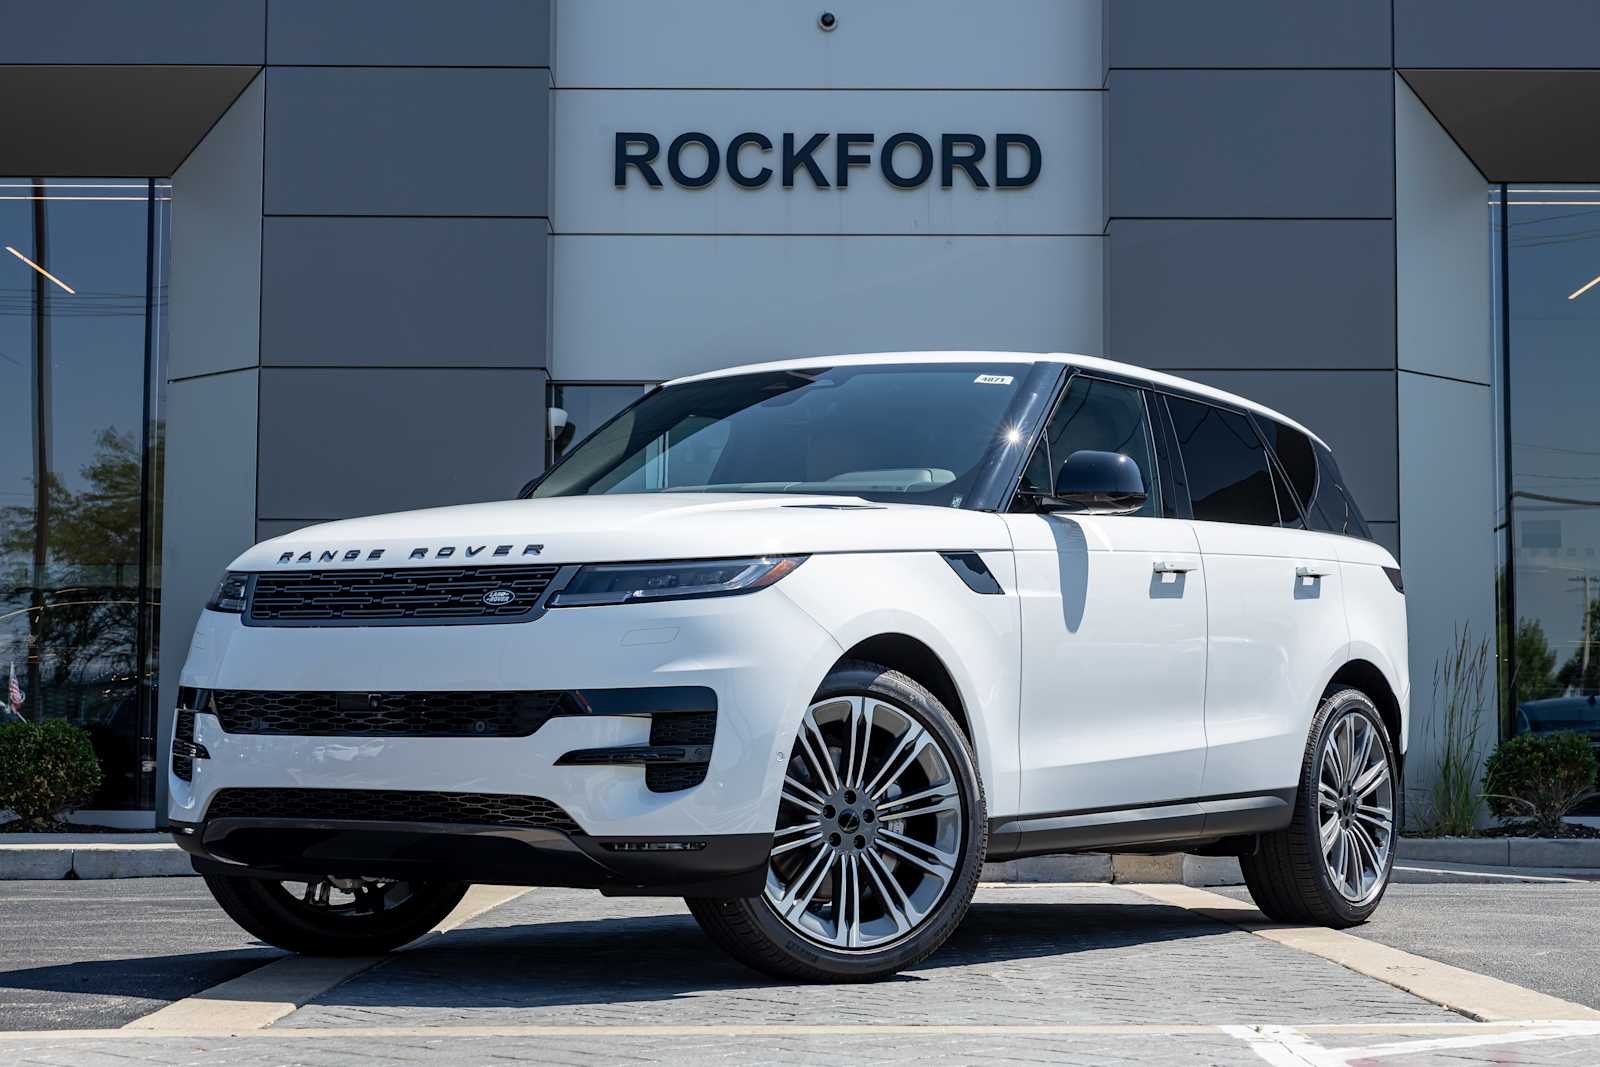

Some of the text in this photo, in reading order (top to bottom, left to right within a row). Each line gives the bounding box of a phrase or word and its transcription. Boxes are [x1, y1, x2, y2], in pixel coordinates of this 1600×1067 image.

[614, 132, 1043, 188] ROCKFORD
[277, 544, 544, 565] RANGE ROVER
